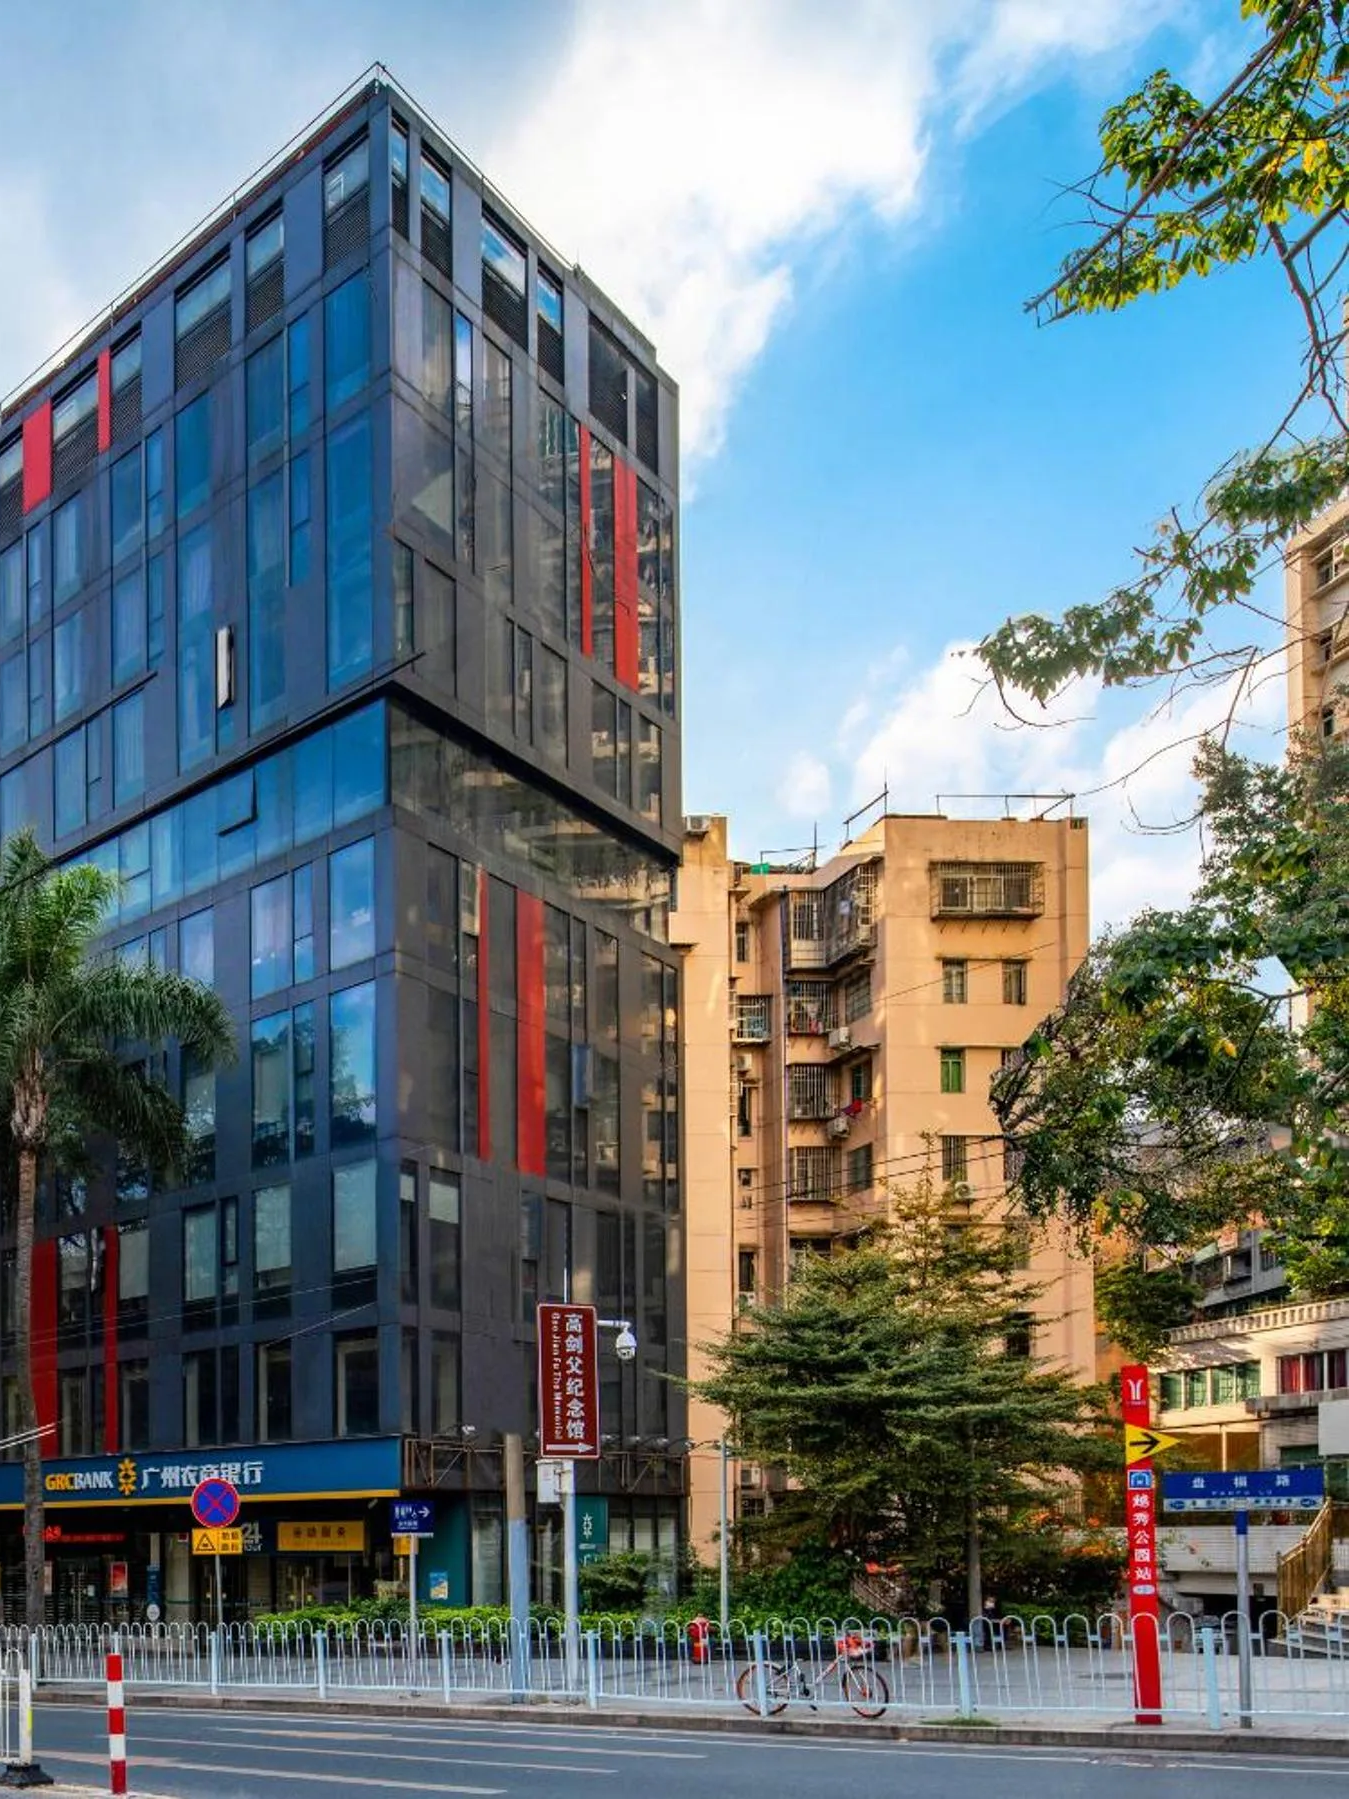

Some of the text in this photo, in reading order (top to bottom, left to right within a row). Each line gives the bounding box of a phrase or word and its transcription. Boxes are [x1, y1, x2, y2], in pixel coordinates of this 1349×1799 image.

[564, 1313, 585, 1440] 高剑父纪念馆
[45, 1471, 114, 1491] GRCBANK
[141, 1461, 264, 1489] 广州农商银行
[1132, 1493, 1152, 1580] 越秀公园站
